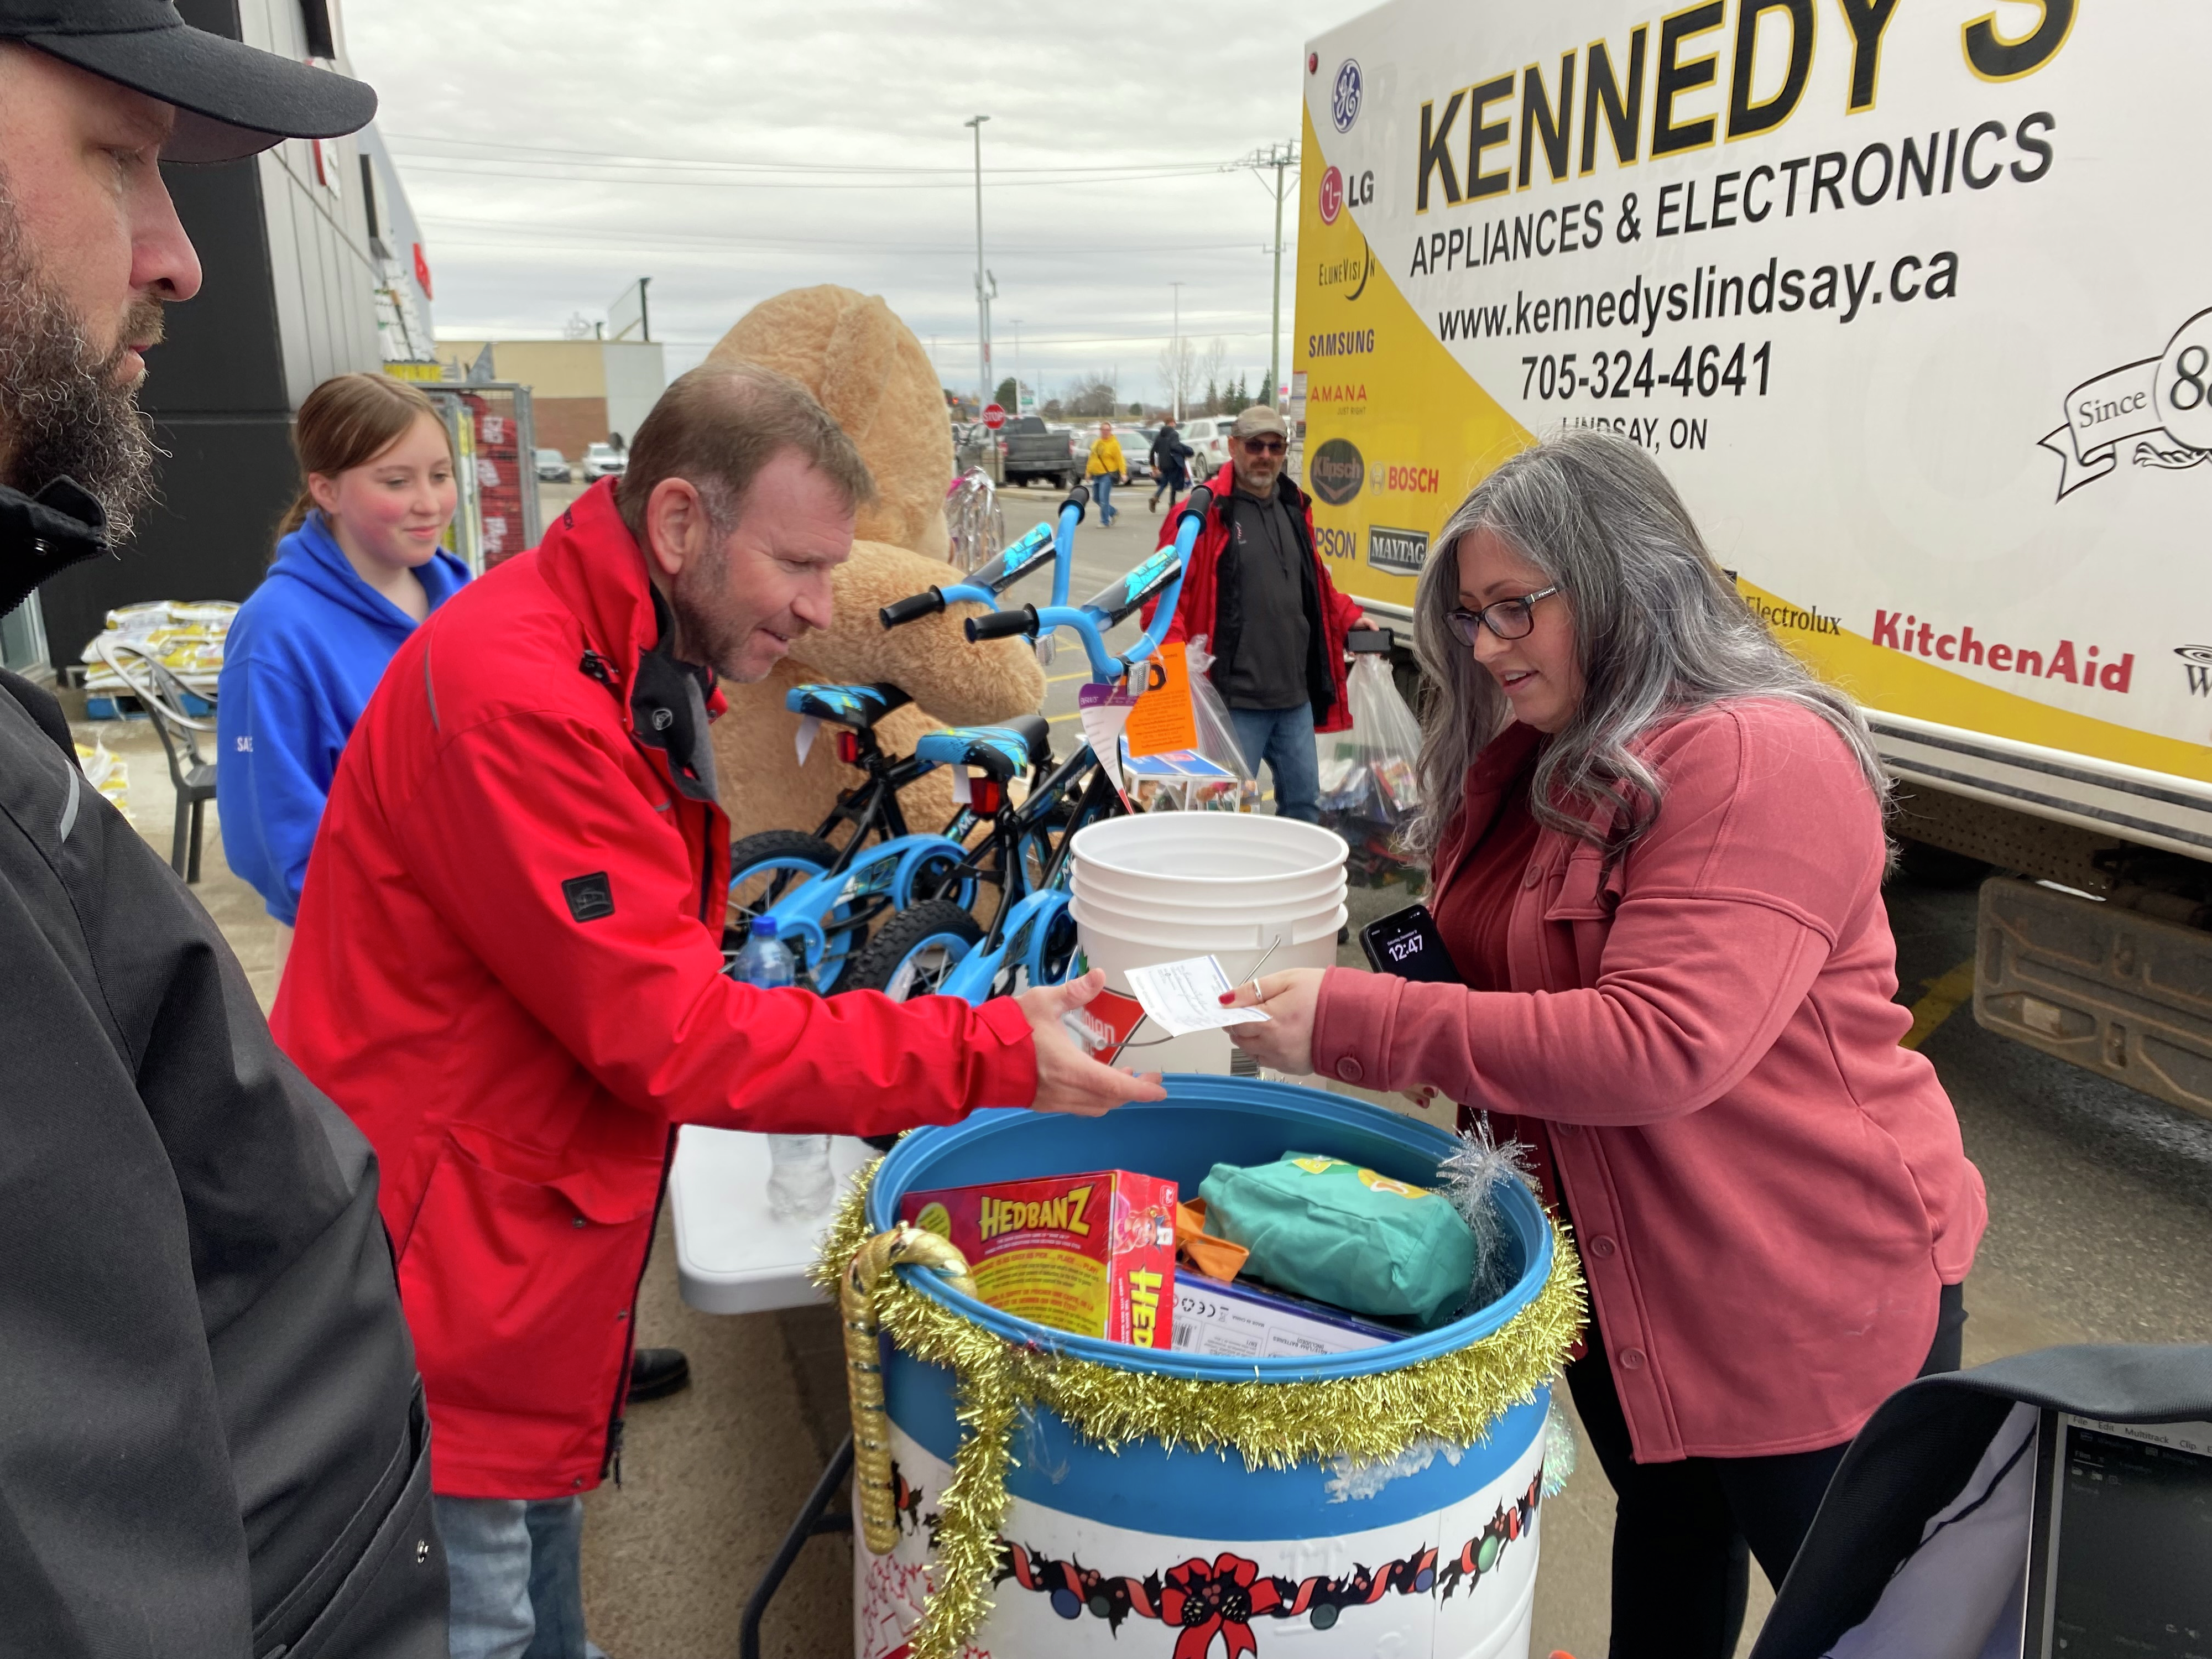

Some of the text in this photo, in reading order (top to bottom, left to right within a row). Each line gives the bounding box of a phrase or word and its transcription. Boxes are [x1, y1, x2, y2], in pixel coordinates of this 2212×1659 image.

[1416, 0, 2080, 215] KENNEDY
[1348, 170, 1375, 208] LG
[1411, 111, 2057, 277] APPLIANCES & ELECTRONICS
[1439, 251, 1959, 342] www.kennedyslindsay.ca
[1308, 329, 1375, 358] SAMSUNG
[1522, 341, 1771, 401] 705-324-4641
[2170, 345, 2212, 411] 8
[1310, 384, 1368, 403] AMANA
[2079, 392, 2147, 428] Since
[983, 411, 1004, 422] STOP
[1670, 418, 1708, 450] ON
[1312, 456, 1361, 482] Klipsch
[1389, 466, 1439, 493] BOSCH
[1314, 527, 1357, 560] PSON
[1371, 535, 1425, 564] MAYTAG
[1872, 609, 2136, 695] KitchenAid
[1389, 934, 1423, 962] 12:47
[979, 1185, 1094, 1241] HEDBANZ
[2073, 1416, 2088, 1426] File
[2098, 1422, 2114, 1432] Edit
[2125, 1427, 2169, 1444] Multitrack
[2180, 1439, 2198, 1451] Clip
